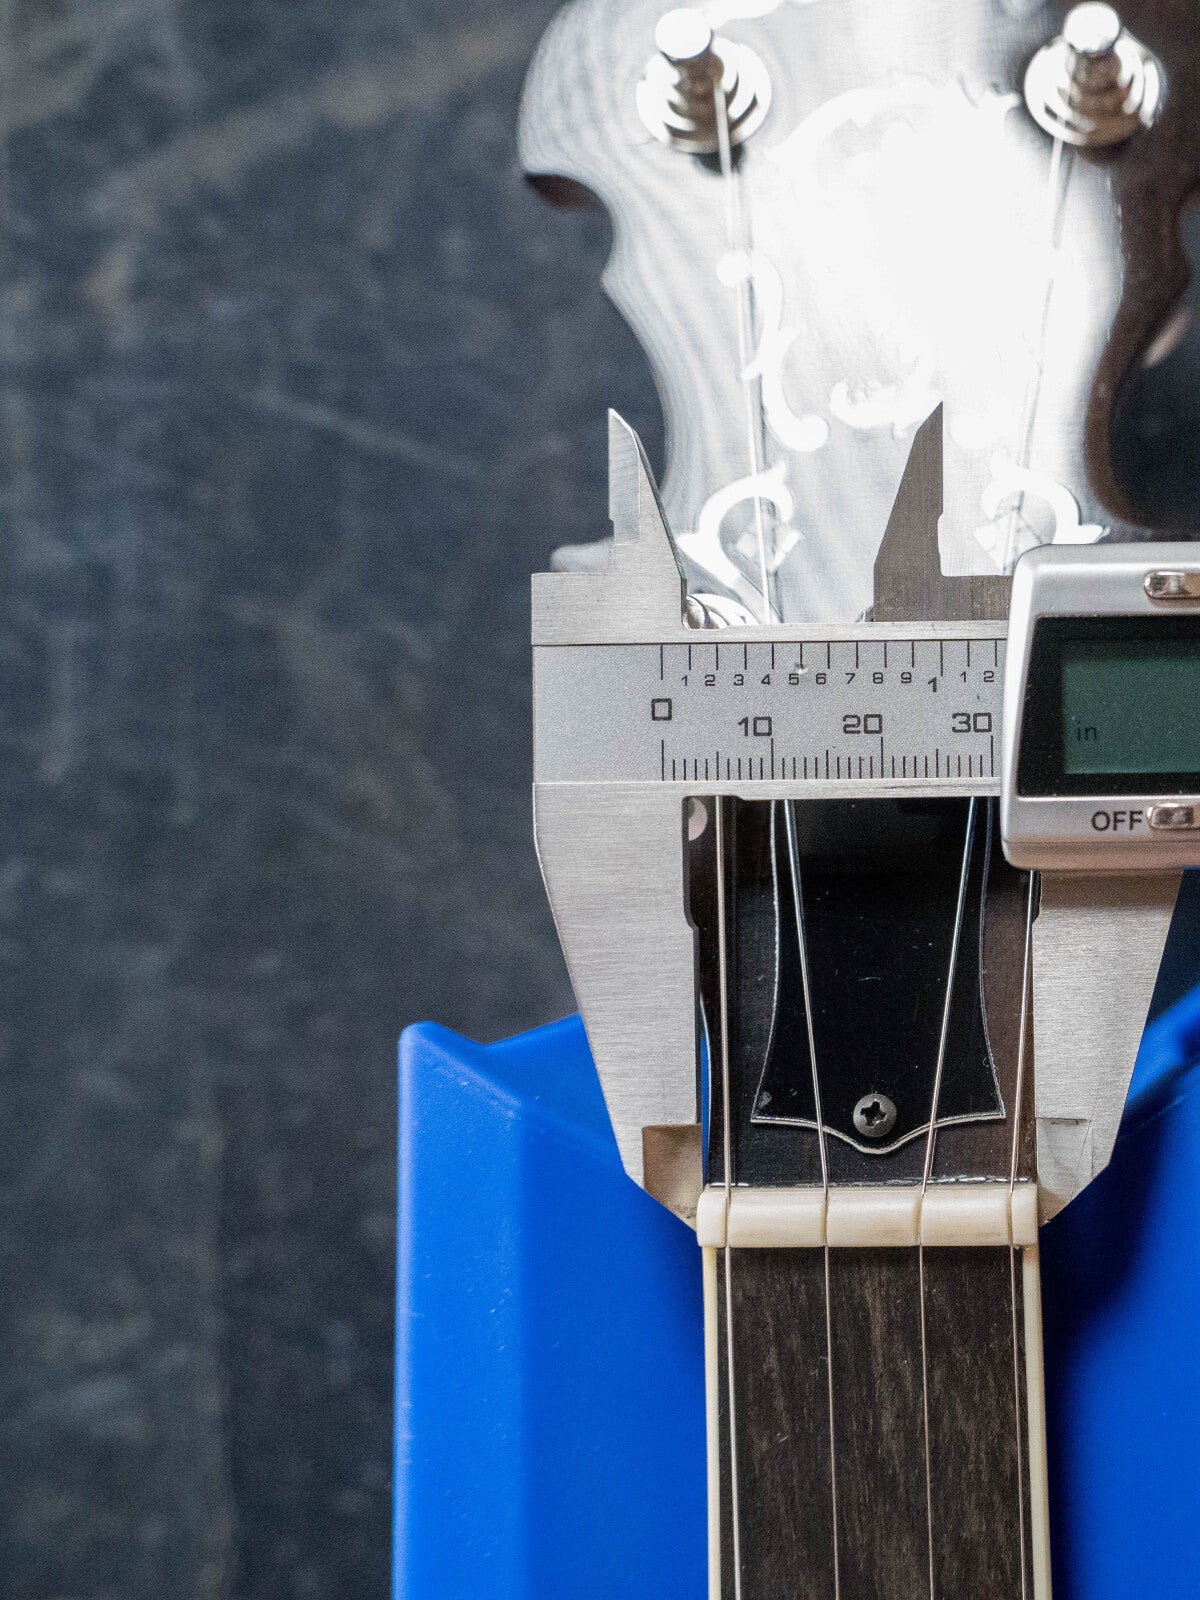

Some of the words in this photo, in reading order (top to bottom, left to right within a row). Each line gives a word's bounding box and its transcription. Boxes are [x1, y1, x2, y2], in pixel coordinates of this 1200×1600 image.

[680, 674, 689, 687] 1
[704, 673, 716, 687] 2
[732, 673, 745, 687] 3
[760, 673, 772, 686] 4
[788, 672, 800, 686] 5
[815, 672, 827, 686] 6
[845, 672, 856, 685] 7
[872, 671, 885, 685] 8
[900, 671, 913, 685] 9
[927, 676, 939, 694] 1
[959, 670, 967, 683] 1
[982, 669, 995, 684] 2
[650, 697, 673, 722] 0
[736, 715, 773, 737] 10
[842, 713, 884, 735] 20
[951, 711, 993, 734] 30
[1076, 720, 1099, 743] in
[1090, 810, 1144, 832] OFF
